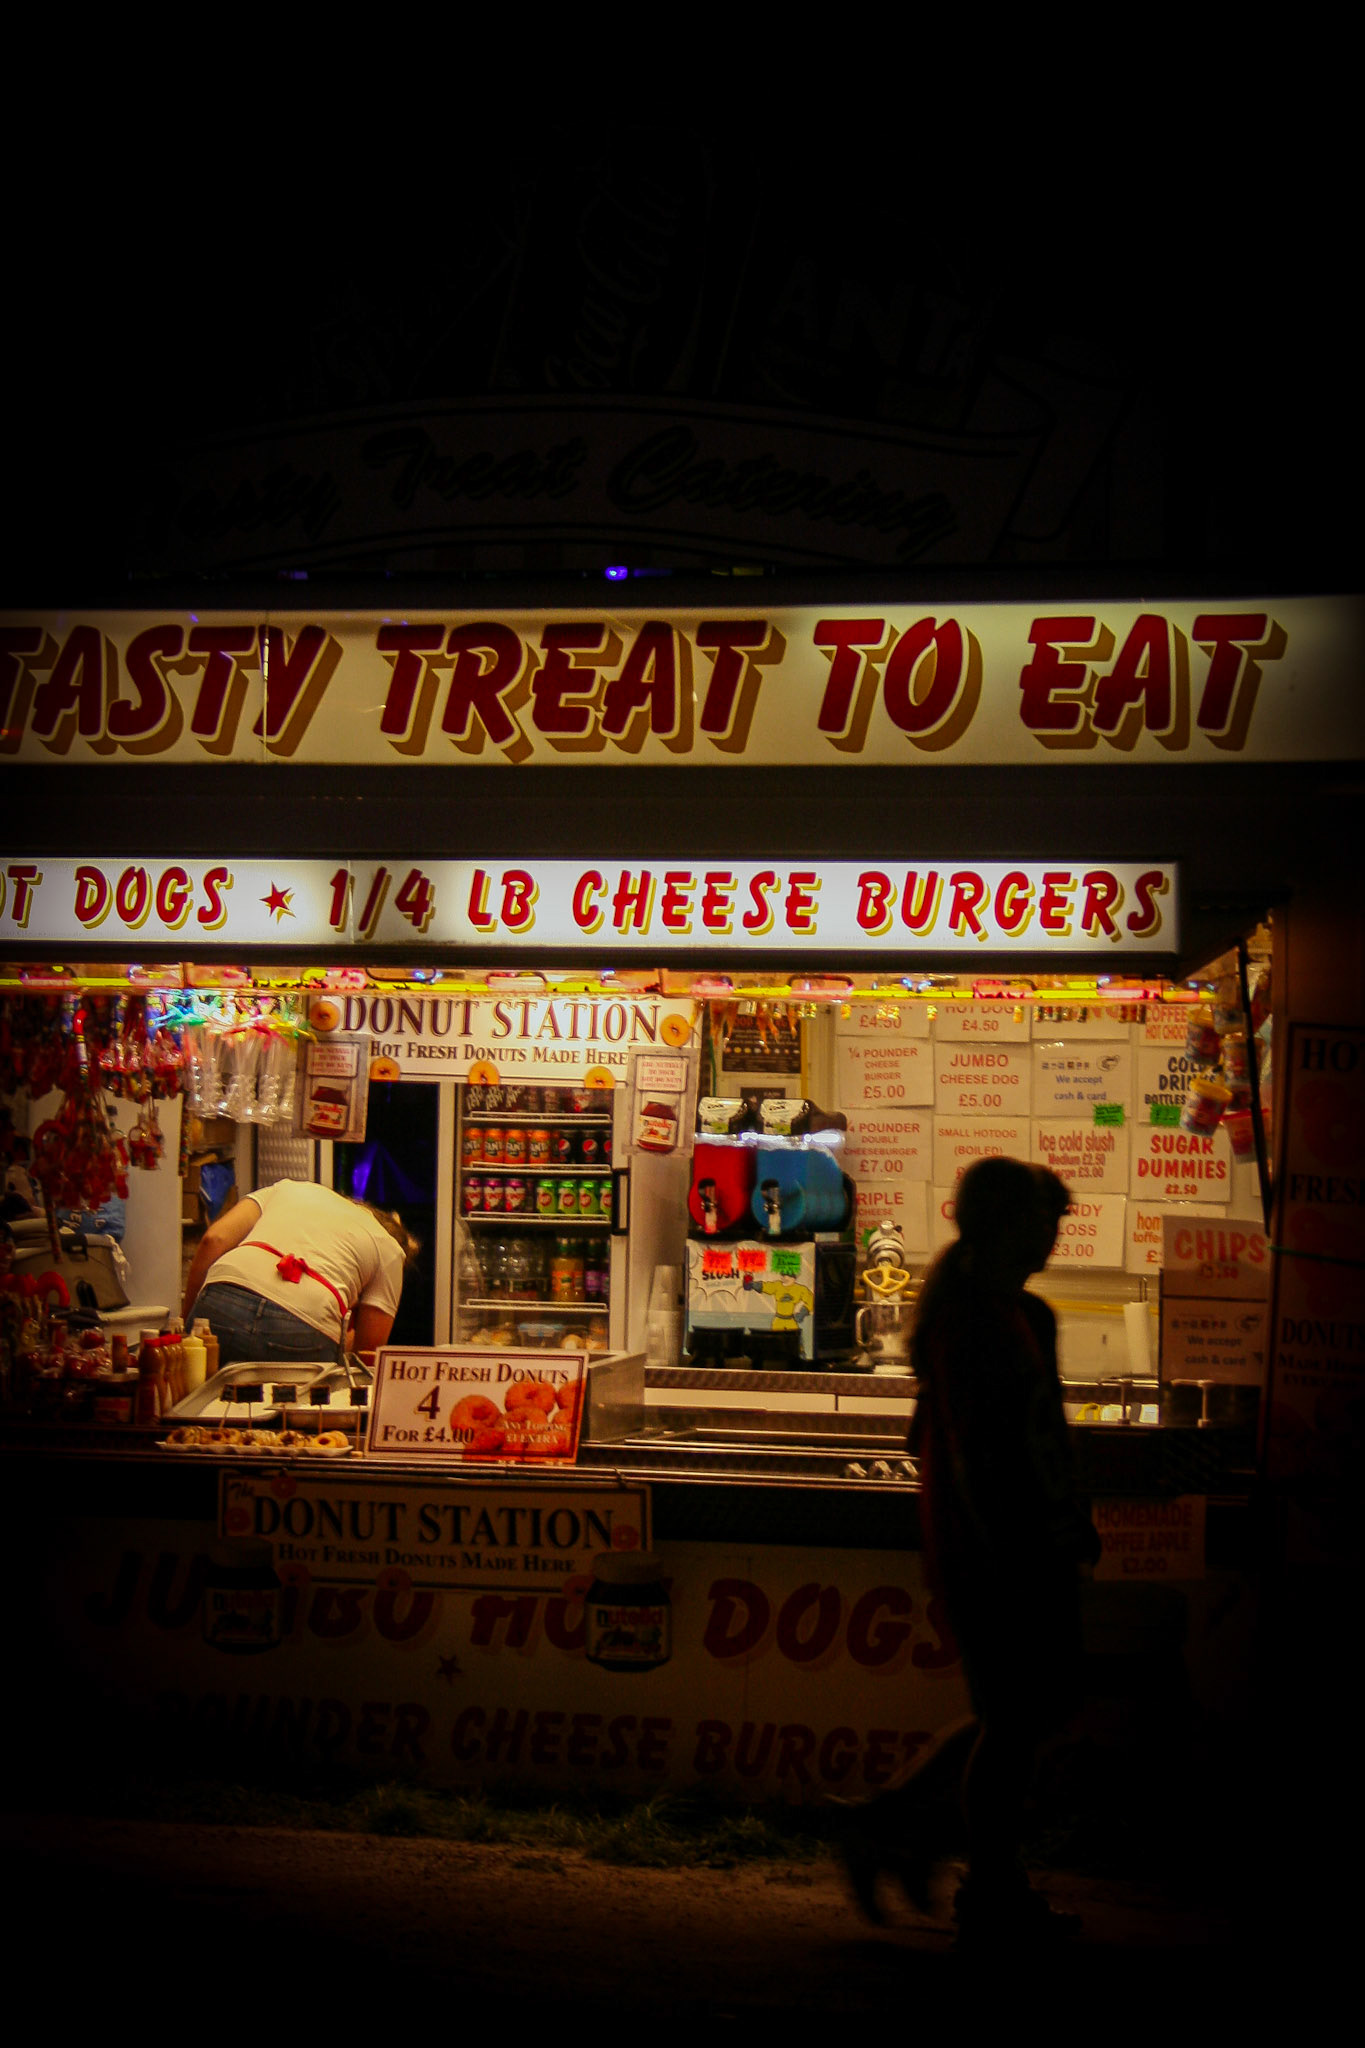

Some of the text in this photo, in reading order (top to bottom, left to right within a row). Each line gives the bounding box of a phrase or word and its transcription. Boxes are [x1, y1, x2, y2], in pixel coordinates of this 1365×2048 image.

[362, 427, 588, 510] Treat
[606, 425, 959, 563] Catering
[0, 613, 1287, 764] TASTY TREAT TO EAT
[74, 866, 233, 931] DOGS
[329, 867, 435, 939] 1/4
[467, 870, 540, 934] LB
[572, 870, 822, 936] CHEESE
[856, 870, 1169, 943] BURGERS
[341, 996, 662, 1043] DONUT STATION
[961, 1019, 999, 1032] £4.50
[407, 1042, 458, 1060] FRESH
[464, 1044, 527, 1063] DONUTS
[533, 1047, 580, 1065] MADE
[585, 1048, 629, 1067] HERE
[863, 1047, 918, 1058] POUNDER
[950, 1053, 1009, 1068] JUMBO
[864, 1060, 900, 1069] CHEESE
[864, 1072, 902, 1081] BURGER
[940, 1074, 1020, 1085] CHEESE DOG
[1055, 1075, 1103, 1086] We accept
[863, 1084, 905, 1099] £5.00
[959, 1093, 1002, 1107] £5.00
[1054, 1091, 1074, 1101] cash
[1086, 1091, 1107, 1101] card
[859, 1122, 920, 1133] POUNDER
[938, 1128, 971, 1138] SMALL
[861, 1135, 899, 1144] DOUBLE
[1039, 1130, 1115, 1153] Ice cold slush
[1150, 1133, 1215, 1155] SUGAR
[859, 1159, 904, 1173] £7.00
[1137, 1157, 1227, 1180] DUMMIES
[1165, 1183, 1199, 1196] £2.50
[859, 1207, 894, 1216] CHEESE
[1174, 1228, 1266, 1263] CHIPS
[390, 1360, 570, 1385] HOT FRESH DONUTS
[413, 1385, 441, 1422] 4
[383, 1424, 475, 1444] FOR £4.00
[255, 1496, 613, 1550] DONUT STATION
[279, 1543, 576, 1574] HOT FRESH DONUTS MADE HERE
[704, 1578, 962, 1670] DOGS
[450, 1704, 672, 1773] CHEESE
